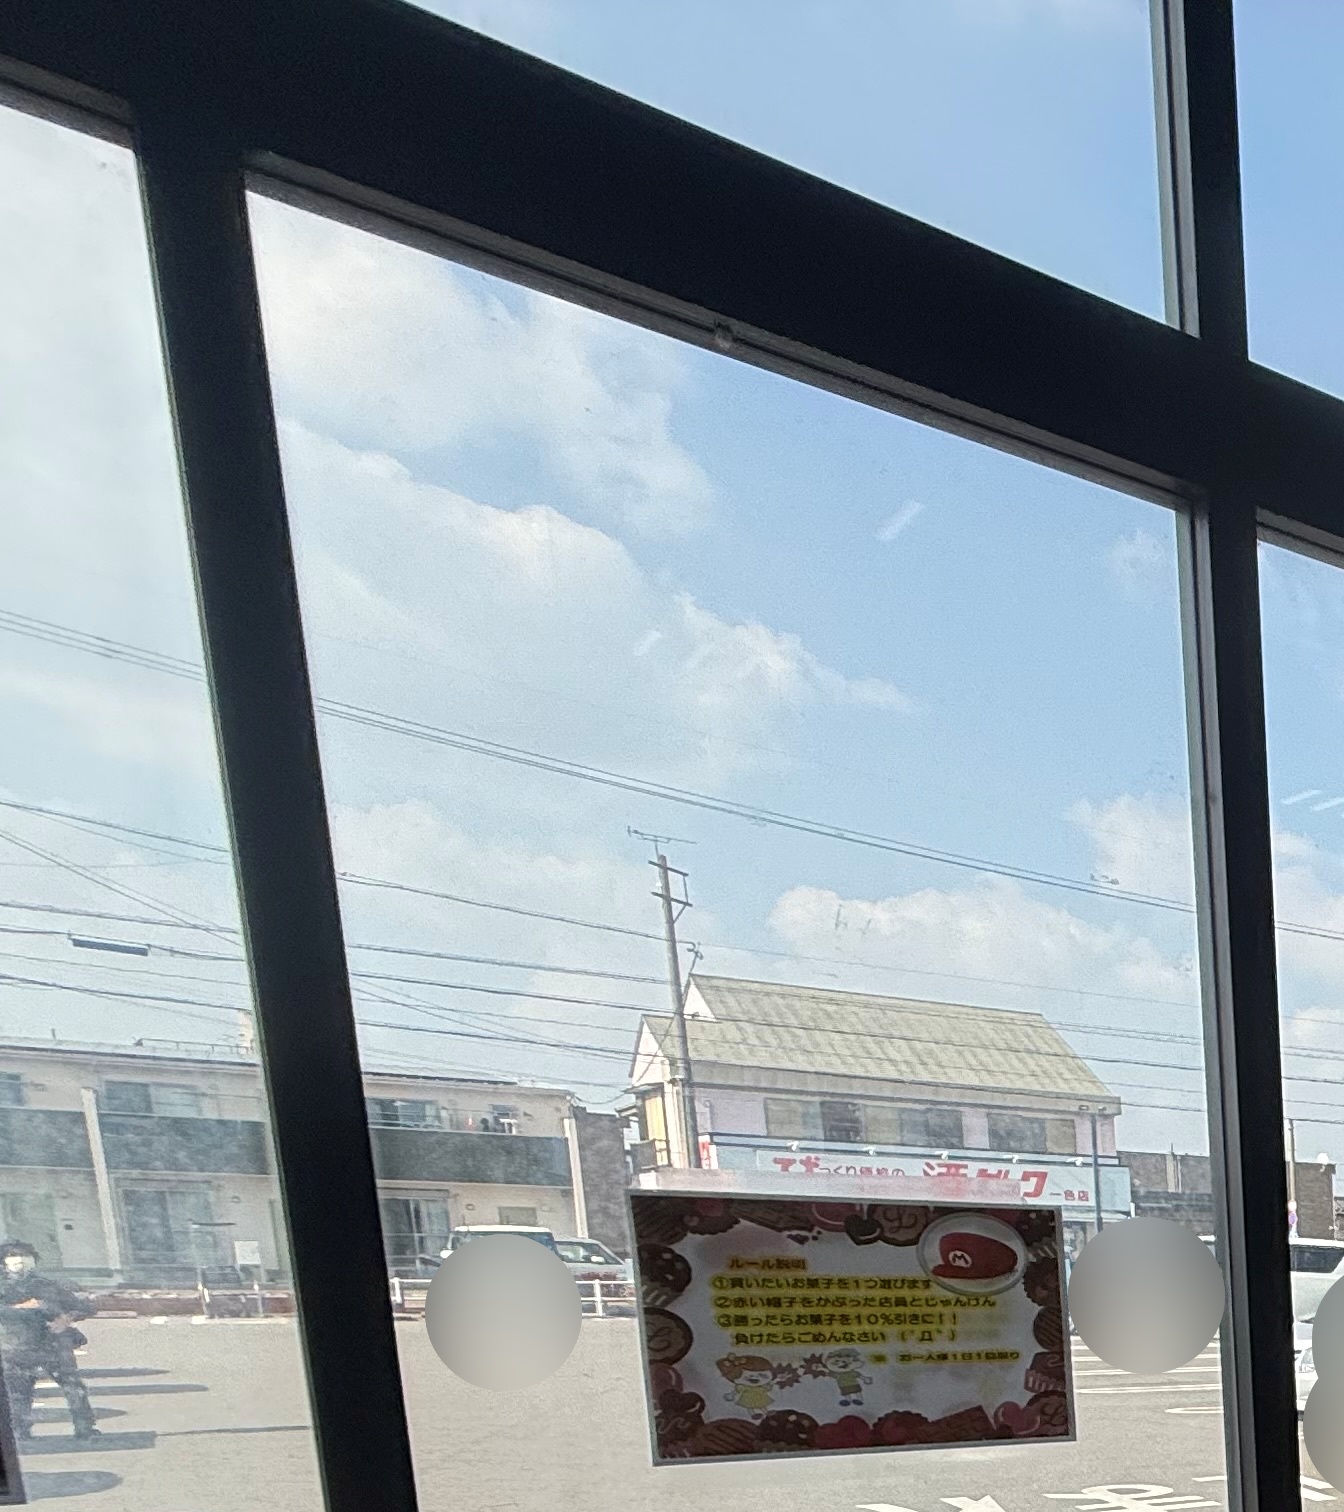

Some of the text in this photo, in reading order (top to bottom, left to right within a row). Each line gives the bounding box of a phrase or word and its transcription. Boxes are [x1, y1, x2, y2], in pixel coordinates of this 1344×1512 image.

[729, 1257, 807, 1271] ルール説明
